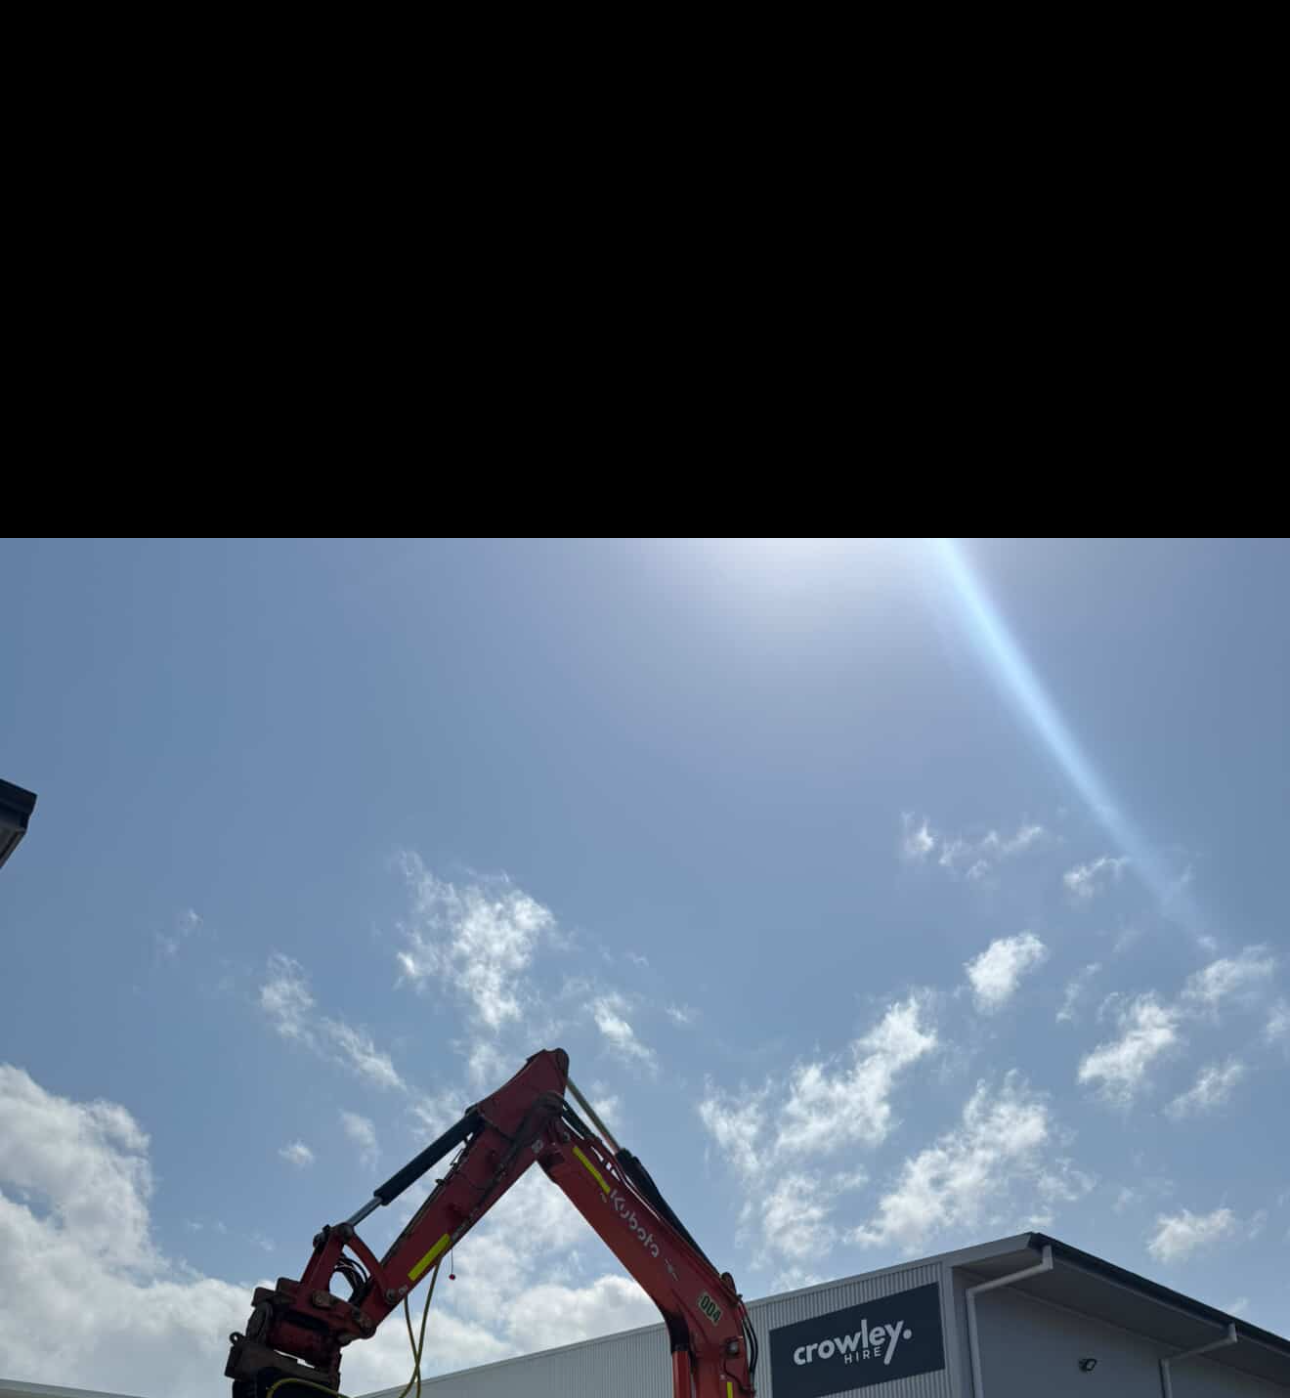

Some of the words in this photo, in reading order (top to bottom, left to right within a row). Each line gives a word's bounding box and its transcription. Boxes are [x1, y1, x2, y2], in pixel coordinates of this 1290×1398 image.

[610, 1189, 659, 1258] Kubota
[793, 1319, 912, 1365] crowley.
[844, 1346, 881, 1364] HIRE
